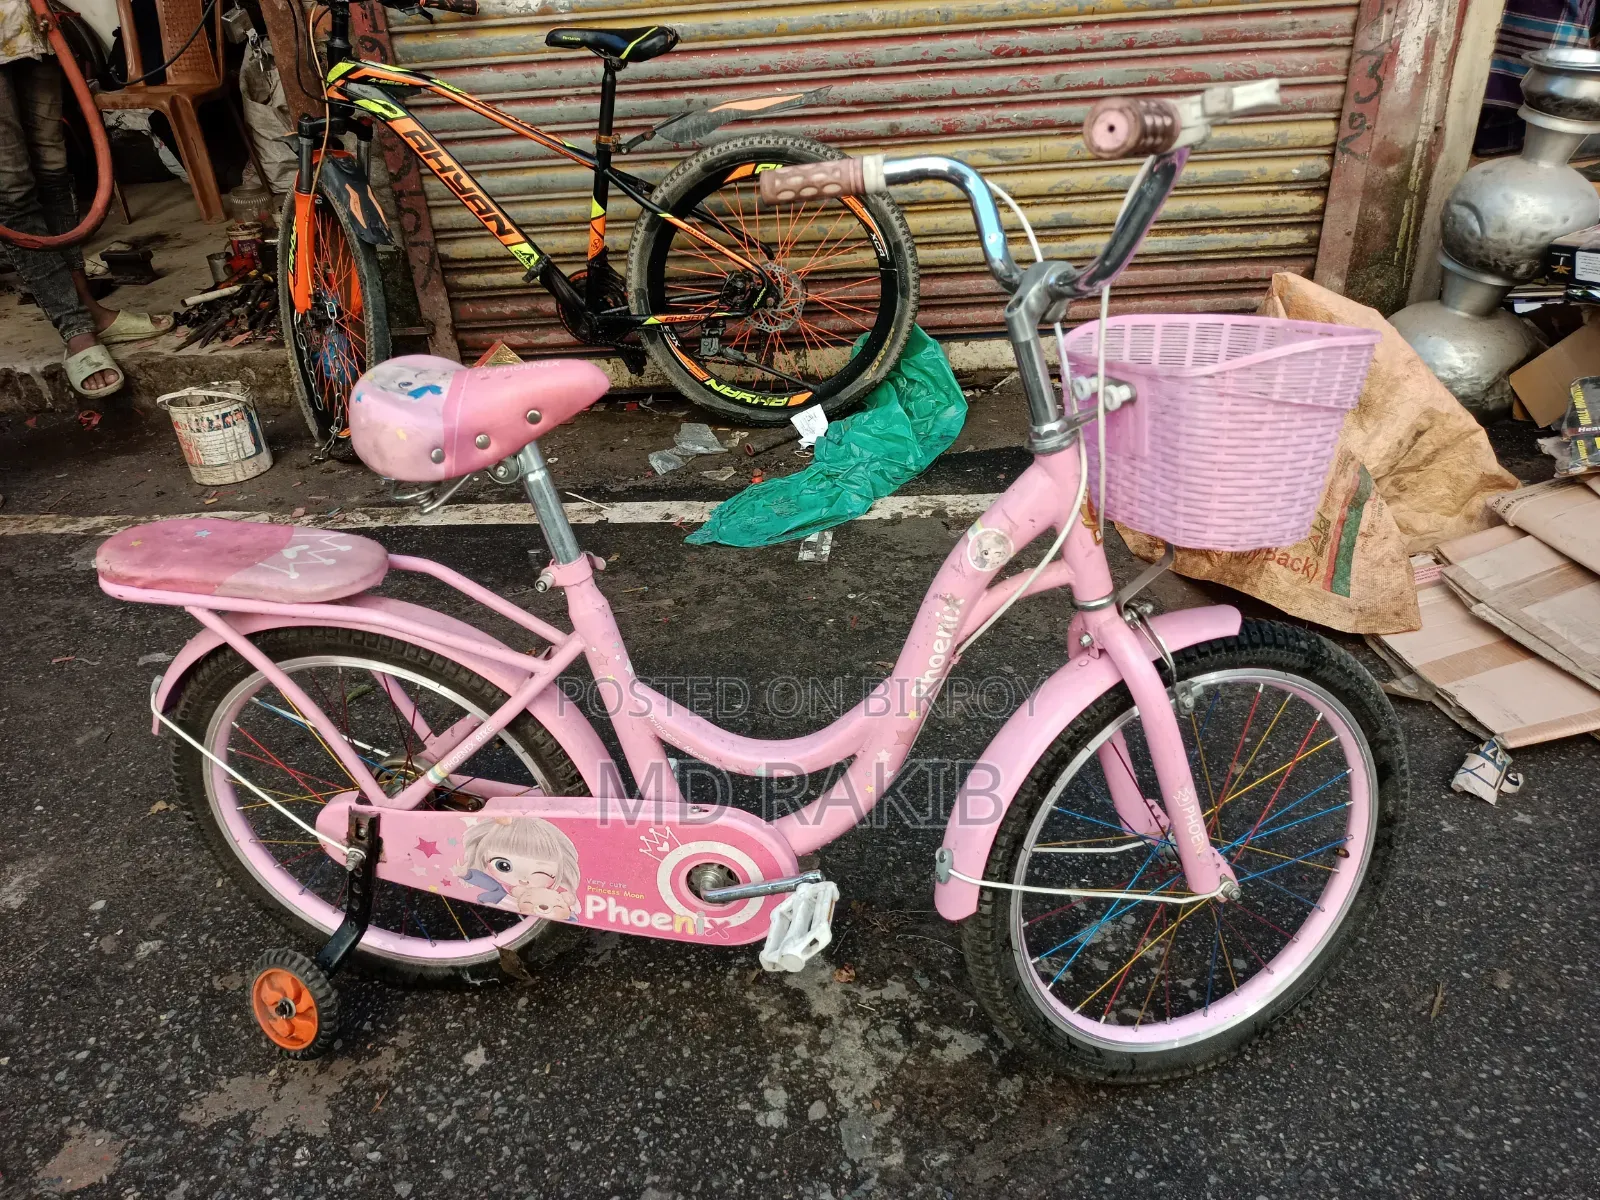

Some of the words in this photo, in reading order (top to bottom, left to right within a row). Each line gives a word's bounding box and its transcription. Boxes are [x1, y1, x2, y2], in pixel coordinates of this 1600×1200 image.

[402, 130, 515, 237] AHYAN
[496, 360, 561, 375] PHOENIX
[703, 378, 789, 407] AHYAN
[443, 740, 476, 771] PHOENIX
[475, 724, 495, 742] BIKE
[648, 711, 682, 746] Princess
[683, 745, 710, 762] Moon
[586, 878, 606, 889] Very
[609, 881, 628, 889] cute
[587, 885, 621, 897] Princess
[623, 890, 645, 900] Moon
[585, 894, 732, 940] Phoenix
